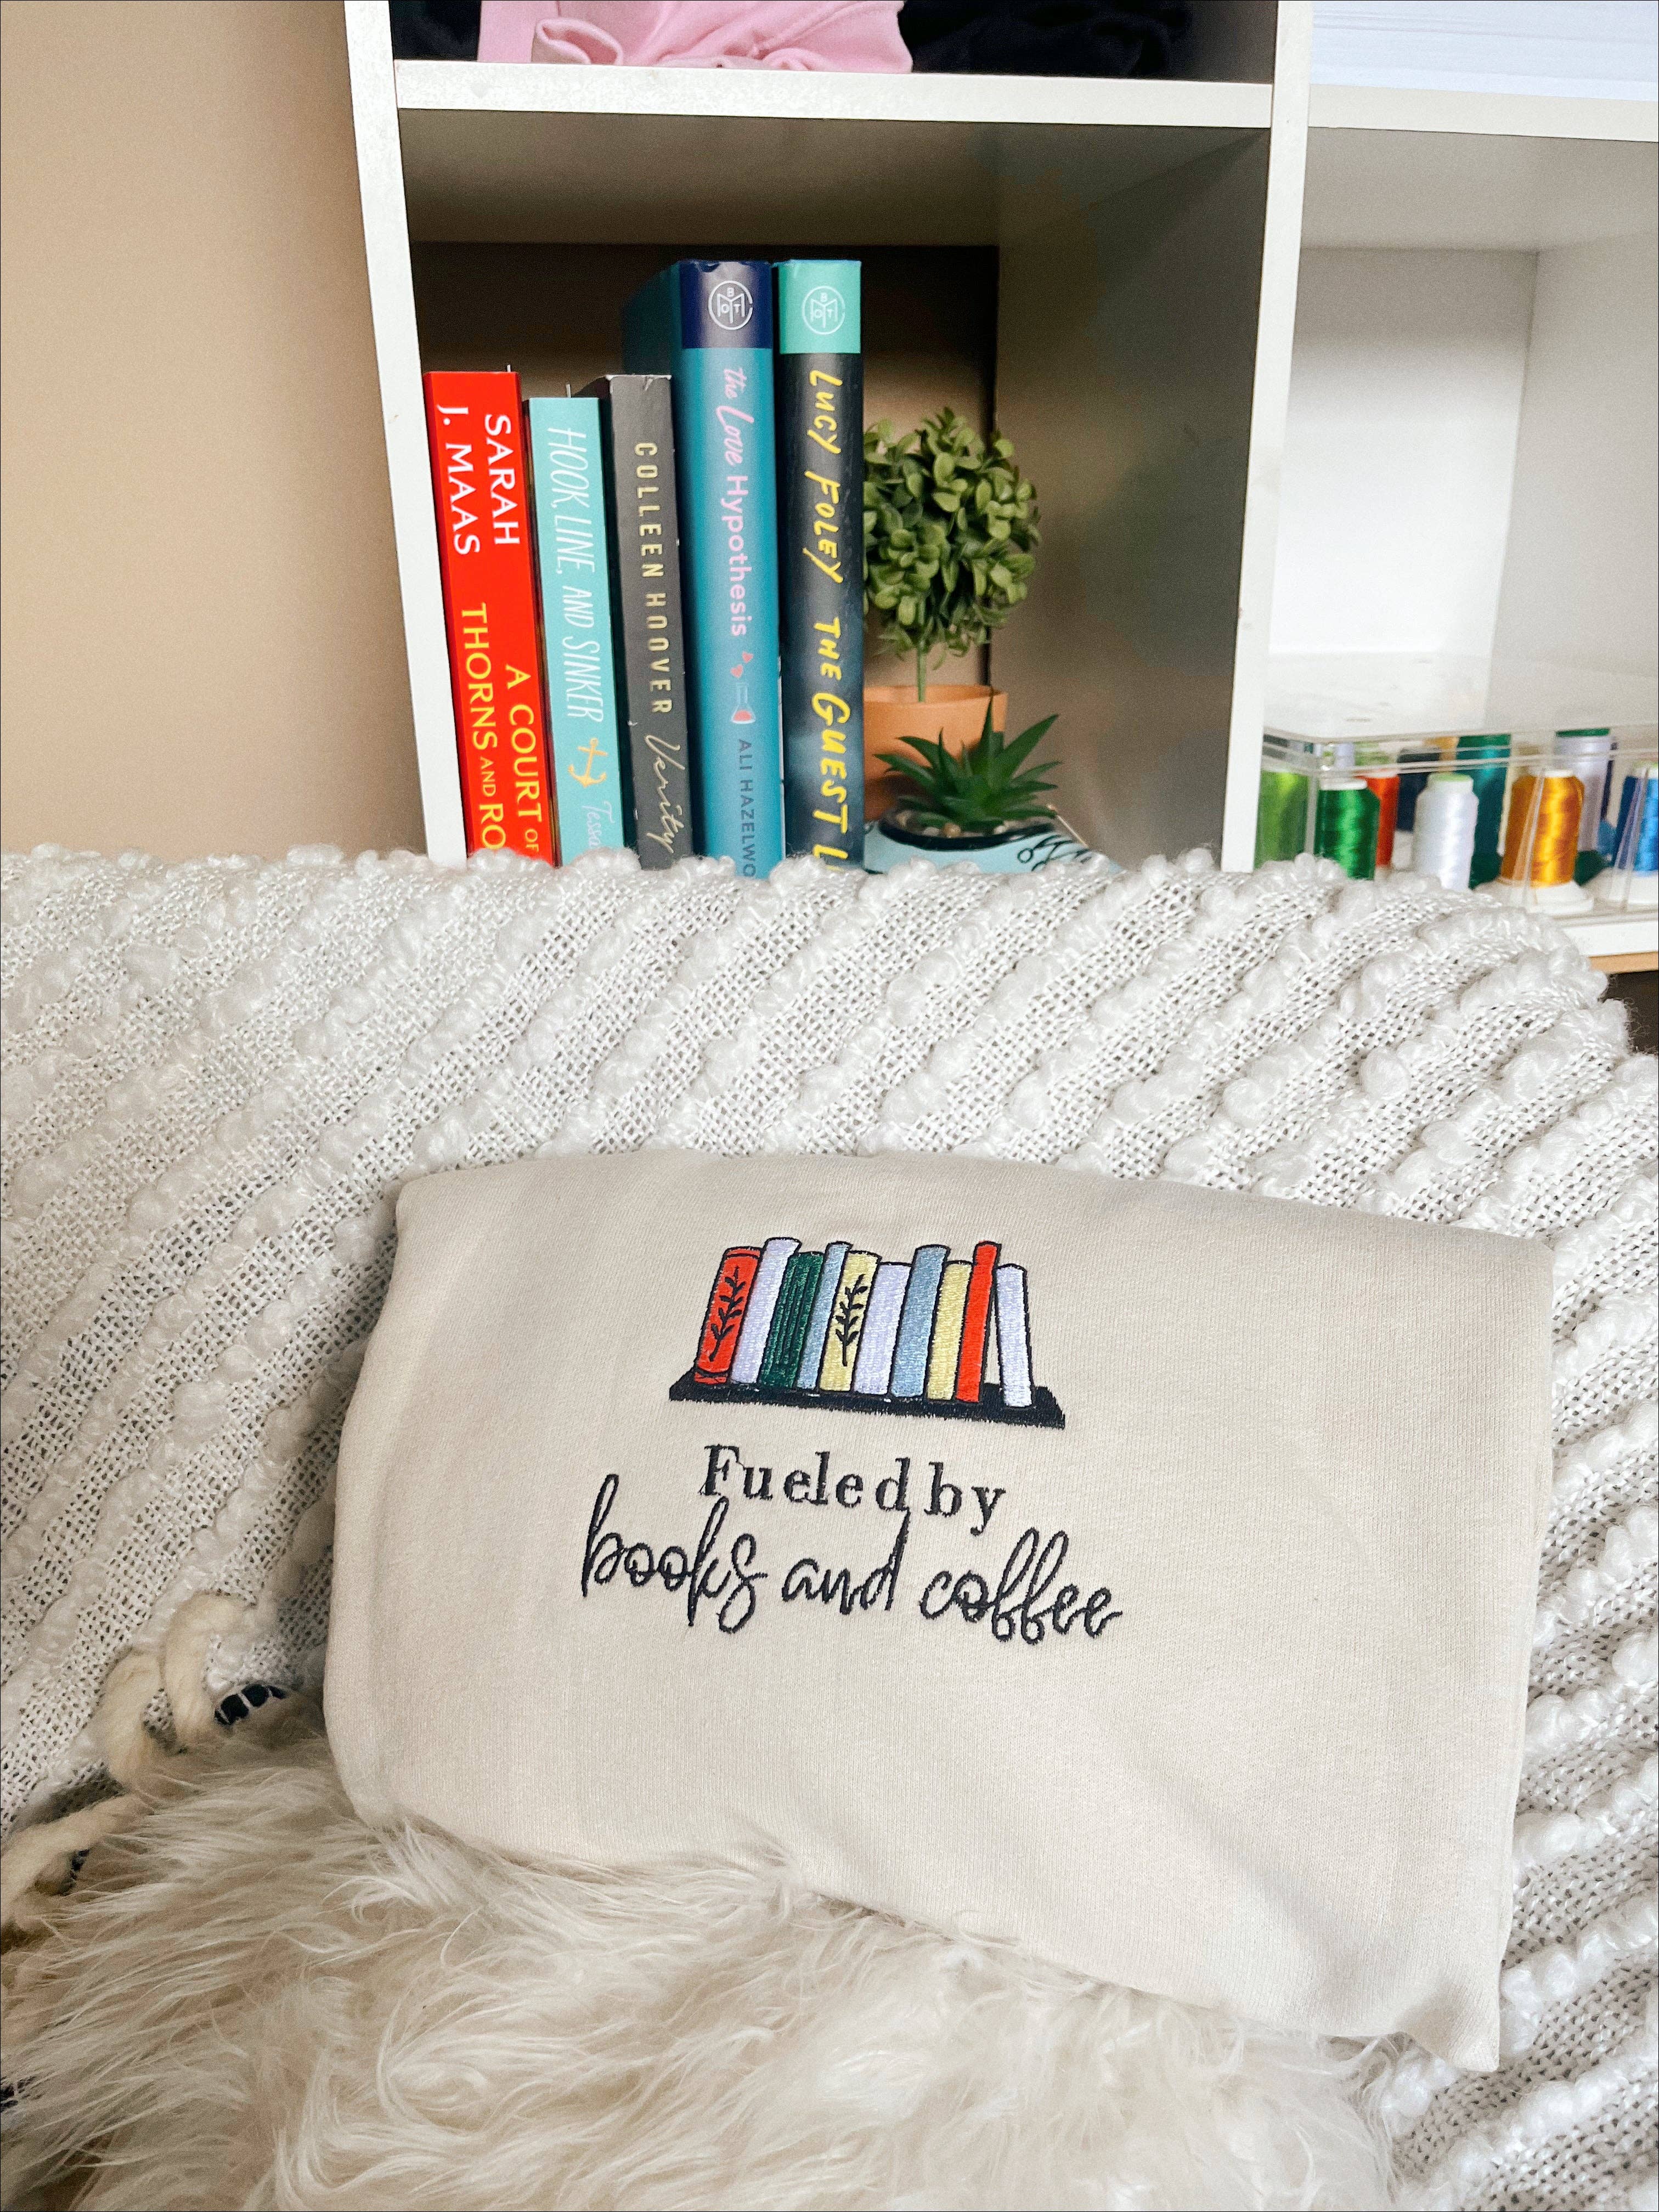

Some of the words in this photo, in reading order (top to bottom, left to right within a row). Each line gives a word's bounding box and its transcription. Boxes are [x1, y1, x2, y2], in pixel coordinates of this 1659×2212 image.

[437, 405, 470, 426] J.
[723, 366, 748, 399] the
[485, 415, 521, 545] SARAH
[715, 405, 755, 466] Love
[445, 443, 481, 555] MAAS
[554, 515, 595, 574] LINE,
[634, 442, 664, 578] COLLEEN
[804, 470, 844, 584] FOLEY
[720, 475, 753, 637] Hypothesis
[562, 585, 595, 629] AND
[645, 592, 673, 714] HOOVER
[814, 617, 842, 681] THE
[462, 602, 498, 751] THORNS
[505, 664, 532, 690] A
[562, 635, 604, 723] SINKER
[480, 757, 497, 798] AND
[509, 704, 543, 823] COURT
[644, 735, 686, 854] Verity
[738, 739, 752, 771] ALI
[812, 692, 851, 834] GUEST
[479, 803, 507, 850] RO
[524, 828, 540, 852] OF
[738, 779, 757, 877] HAZELWO
[699, 1443, 911, 1513] Fueled
[923, 1462, 1006, 1536] by
[581, 1474, 769, 1634] books
[782, 1508, 911, 1616] and
[918, 1527, 1123, 1646] coffee
